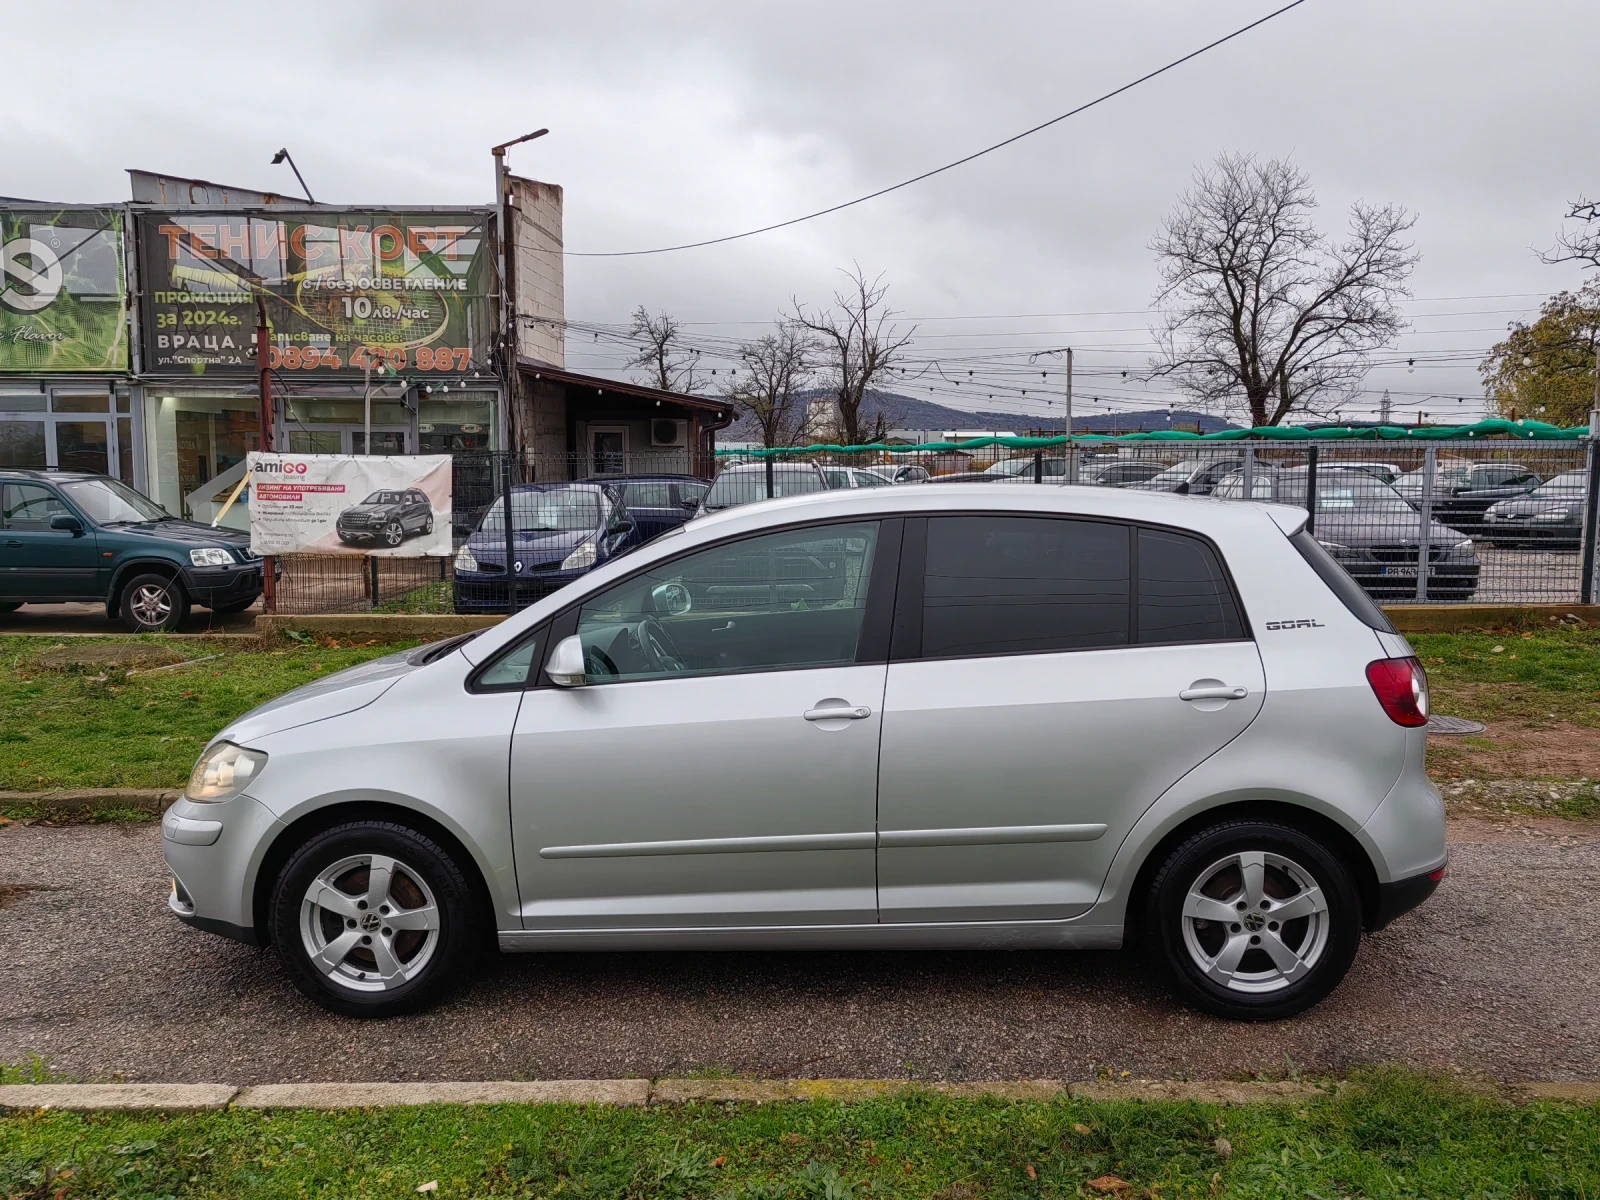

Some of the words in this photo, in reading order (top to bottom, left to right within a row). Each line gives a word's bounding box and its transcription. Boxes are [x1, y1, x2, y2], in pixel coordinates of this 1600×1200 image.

[158, 224, 324, 260] ТЕНИС
[338, 224, 466, 261] КОРТ
[327, 277, 354, 291] без
[357, 277, 468, 291] ОСВЕТЛЕНИЕ
[154, 291, 254, 306] ПРОМОЦИЯ
[156, 313, 178, 328] за
[11, 325, 65, 344] Flavor
[269, 332, 332, 342] аписване
[269, 345, 343, 370] 0894
[349, 346, 407, 370] 420
[415, 346, 473, 371] 887
